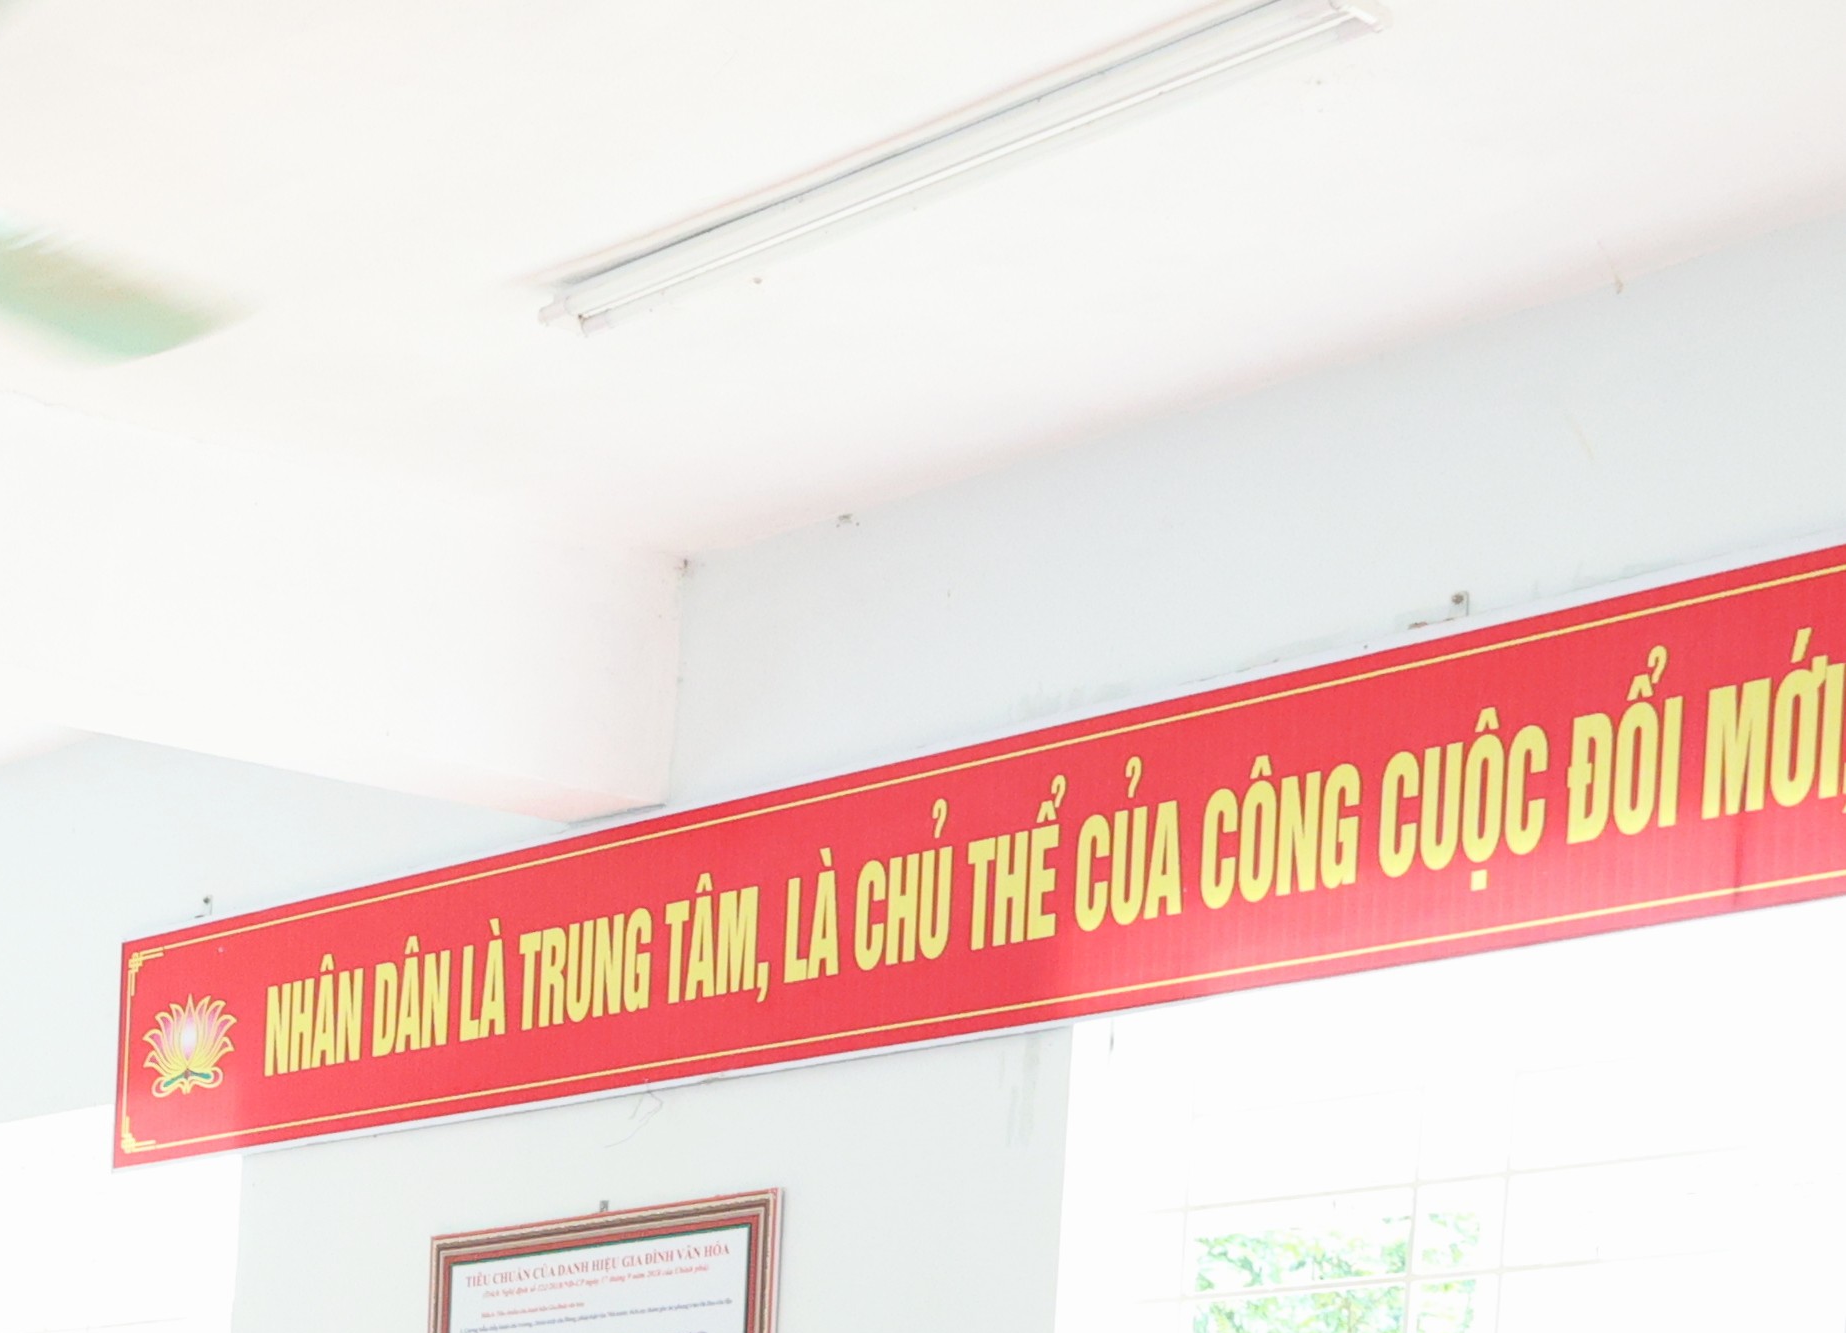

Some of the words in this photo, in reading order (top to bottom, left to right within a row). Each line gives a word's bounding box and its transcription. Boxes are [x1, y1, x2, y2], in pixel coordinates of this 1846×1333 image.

[266, 956, 363, 1076] NHÂN
[374, 937, 450, 1057] DÂN
[460, 920, 506, 1041] LÀ
[520, 908, 651, 1029] TRUNG
[666, 873, 769, 1003] TÂM,
[785, 848, 839, 983] LÀ
[854, 799, 953, 970] CHỦ
[969, 776, 1066, 950] THỂ
[1076, 757, 1182, 931] CỦA
[1202, 756, 1361, 909] CÔNG
[1380, 708, 1548, 889] CUỘC
[1567, 646, 1683, 843] ĐỔI
[1702, 627, 1846, 820] MỚI
[557, 1261, 589, 1277] DANH
[592, 1255, 619, 1273] HIỆU
[622, 1253, 643, 1268] GIA
[645, 1248, 675, 1265] ĐÌNH
[677, 1244, 701, 1260] VĂN
